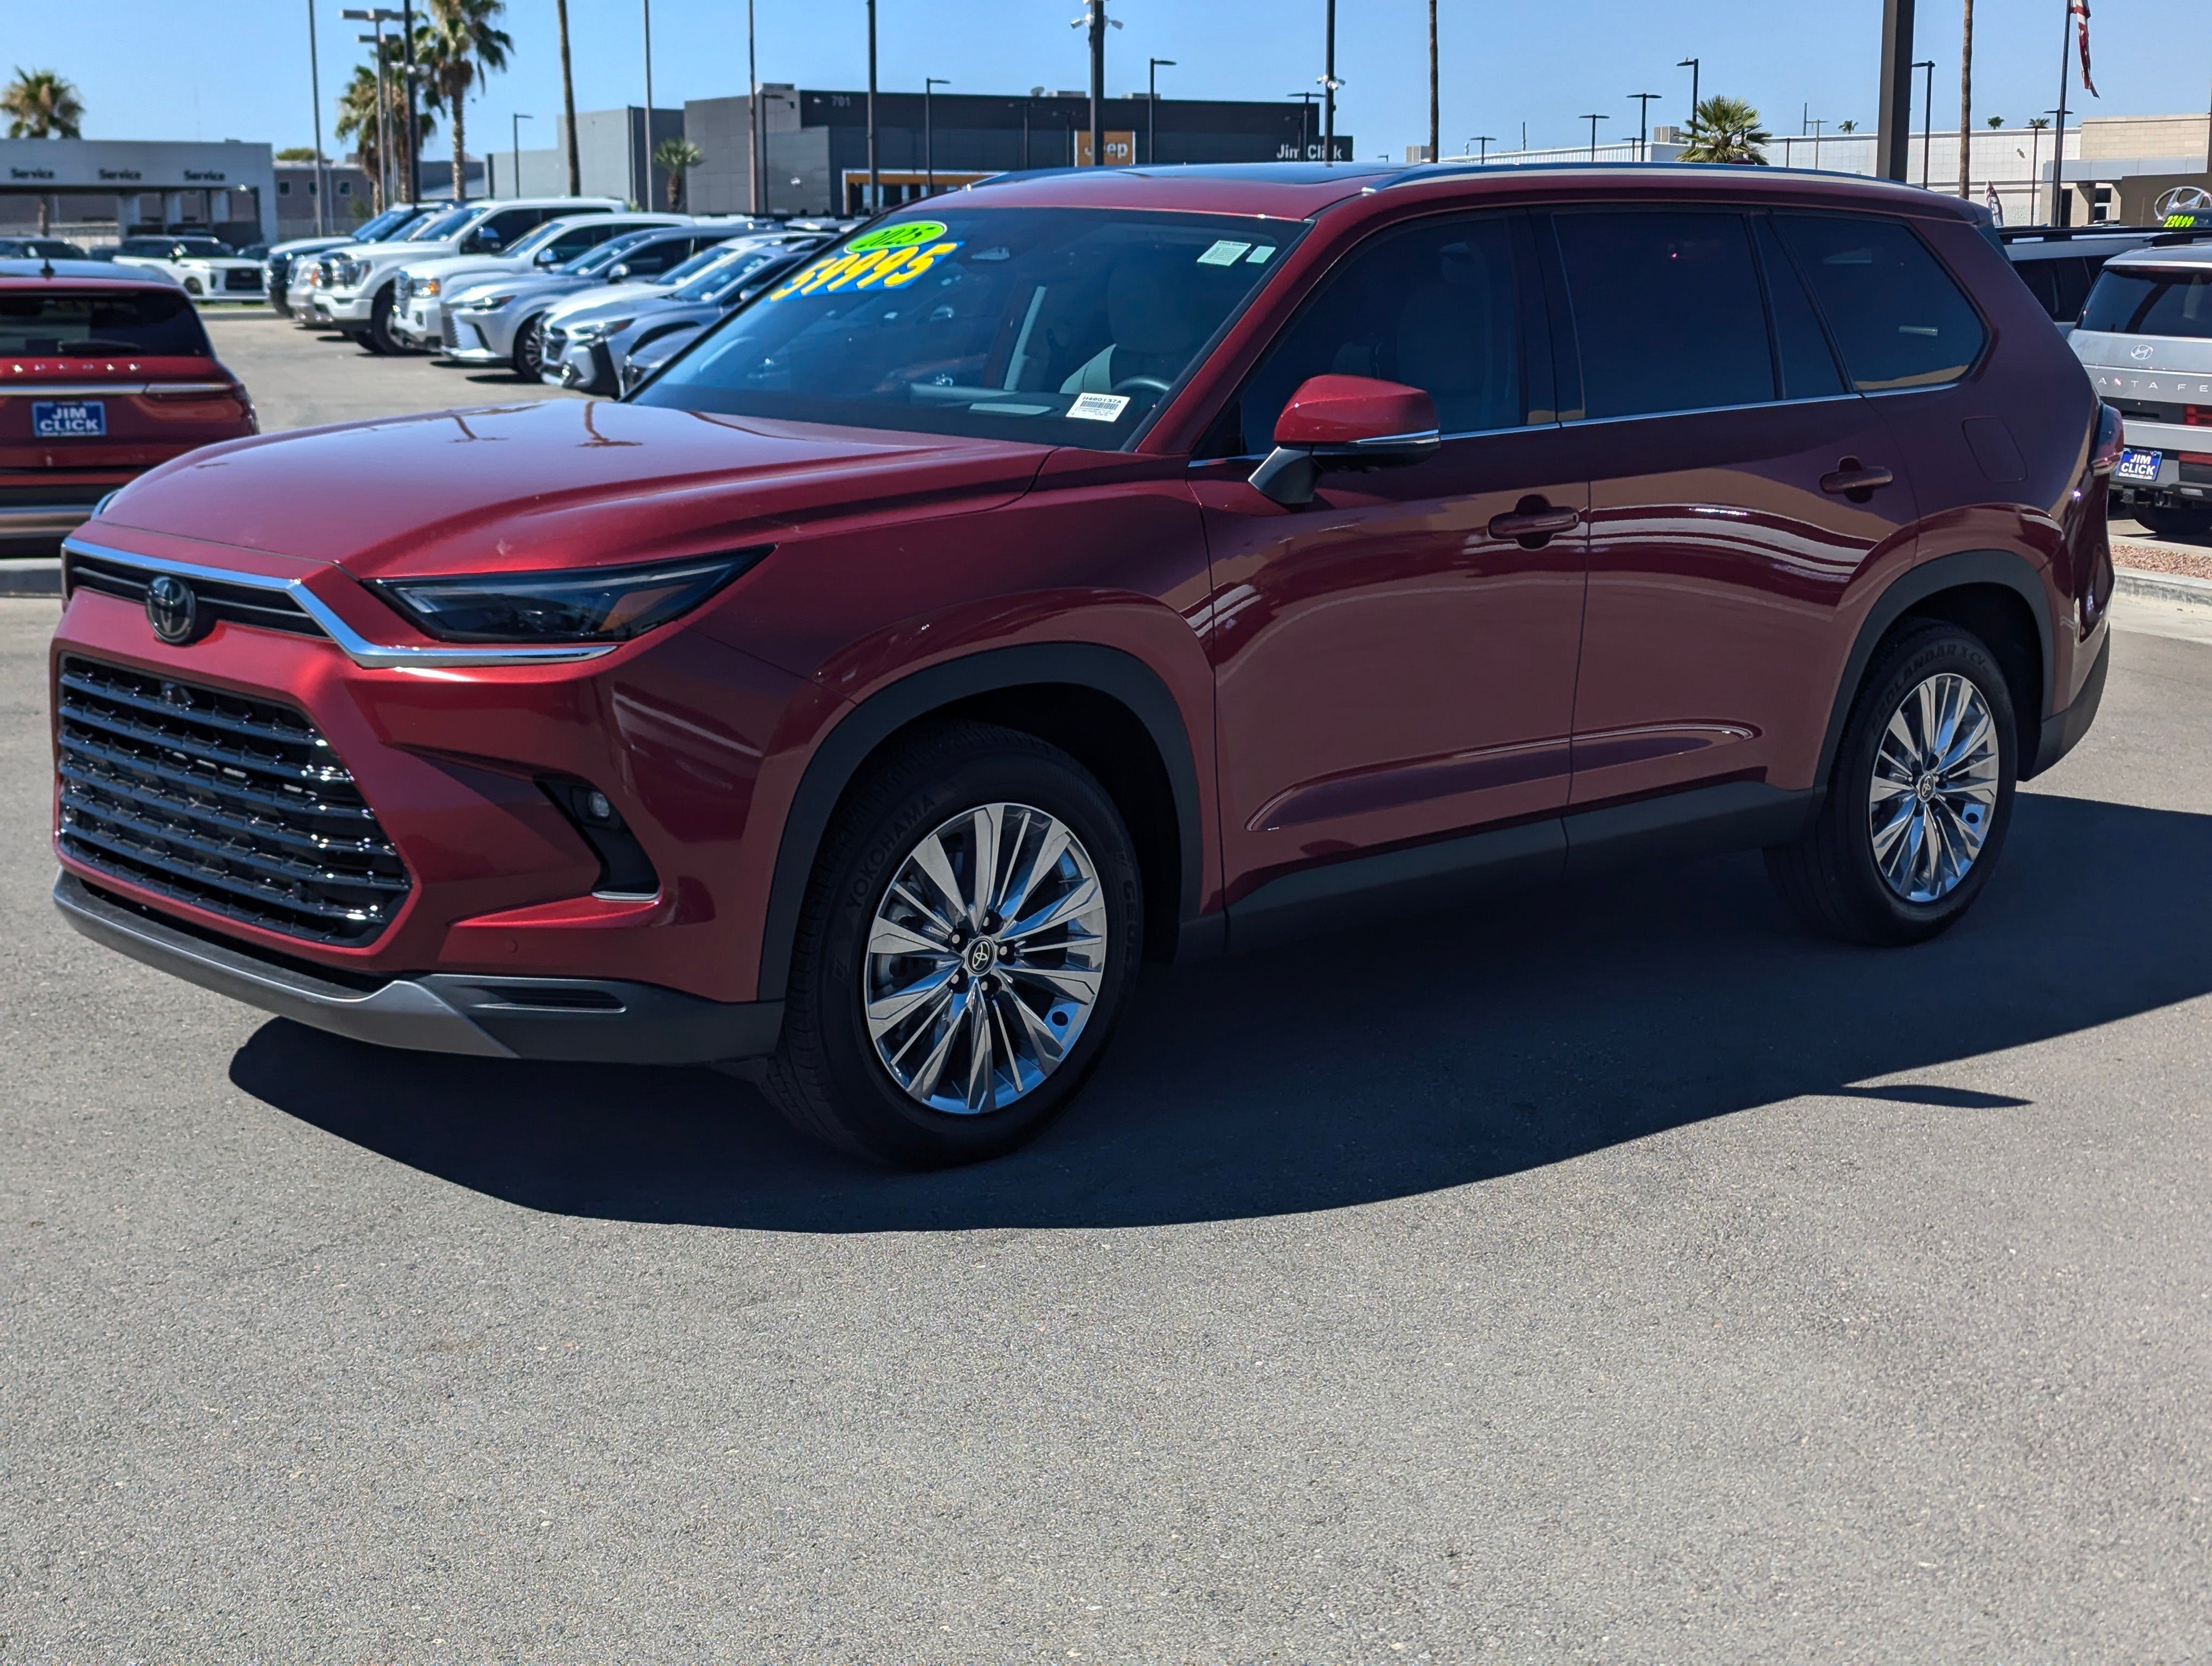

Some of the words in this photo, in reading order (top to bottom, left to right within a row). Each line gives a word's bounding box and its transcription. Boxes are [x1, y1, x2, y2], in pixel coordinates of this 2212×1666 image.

[831, 95, 851, 107] 701
[1276, 143, 1300, 159] Jim
[1307, 144, 1342, 159] Clik
[11, 168, 55, 180] Service
[99, 168, 142, 180] Service
[184, 169, 226, 181] Service
[769, 242, 958, 301] 59995
[2096, 376, 2158, 389] ANTA
[2177, 383, 2209, 392] FE
[52, 407, 87, 420] JIM
[40, 419, 99, 431] CLICK
[2130, 453, 2151, 464] JIM
[2120, 462, 2156, 476] CLICK
[845, 793, 936, 909] YOKOHAMA
